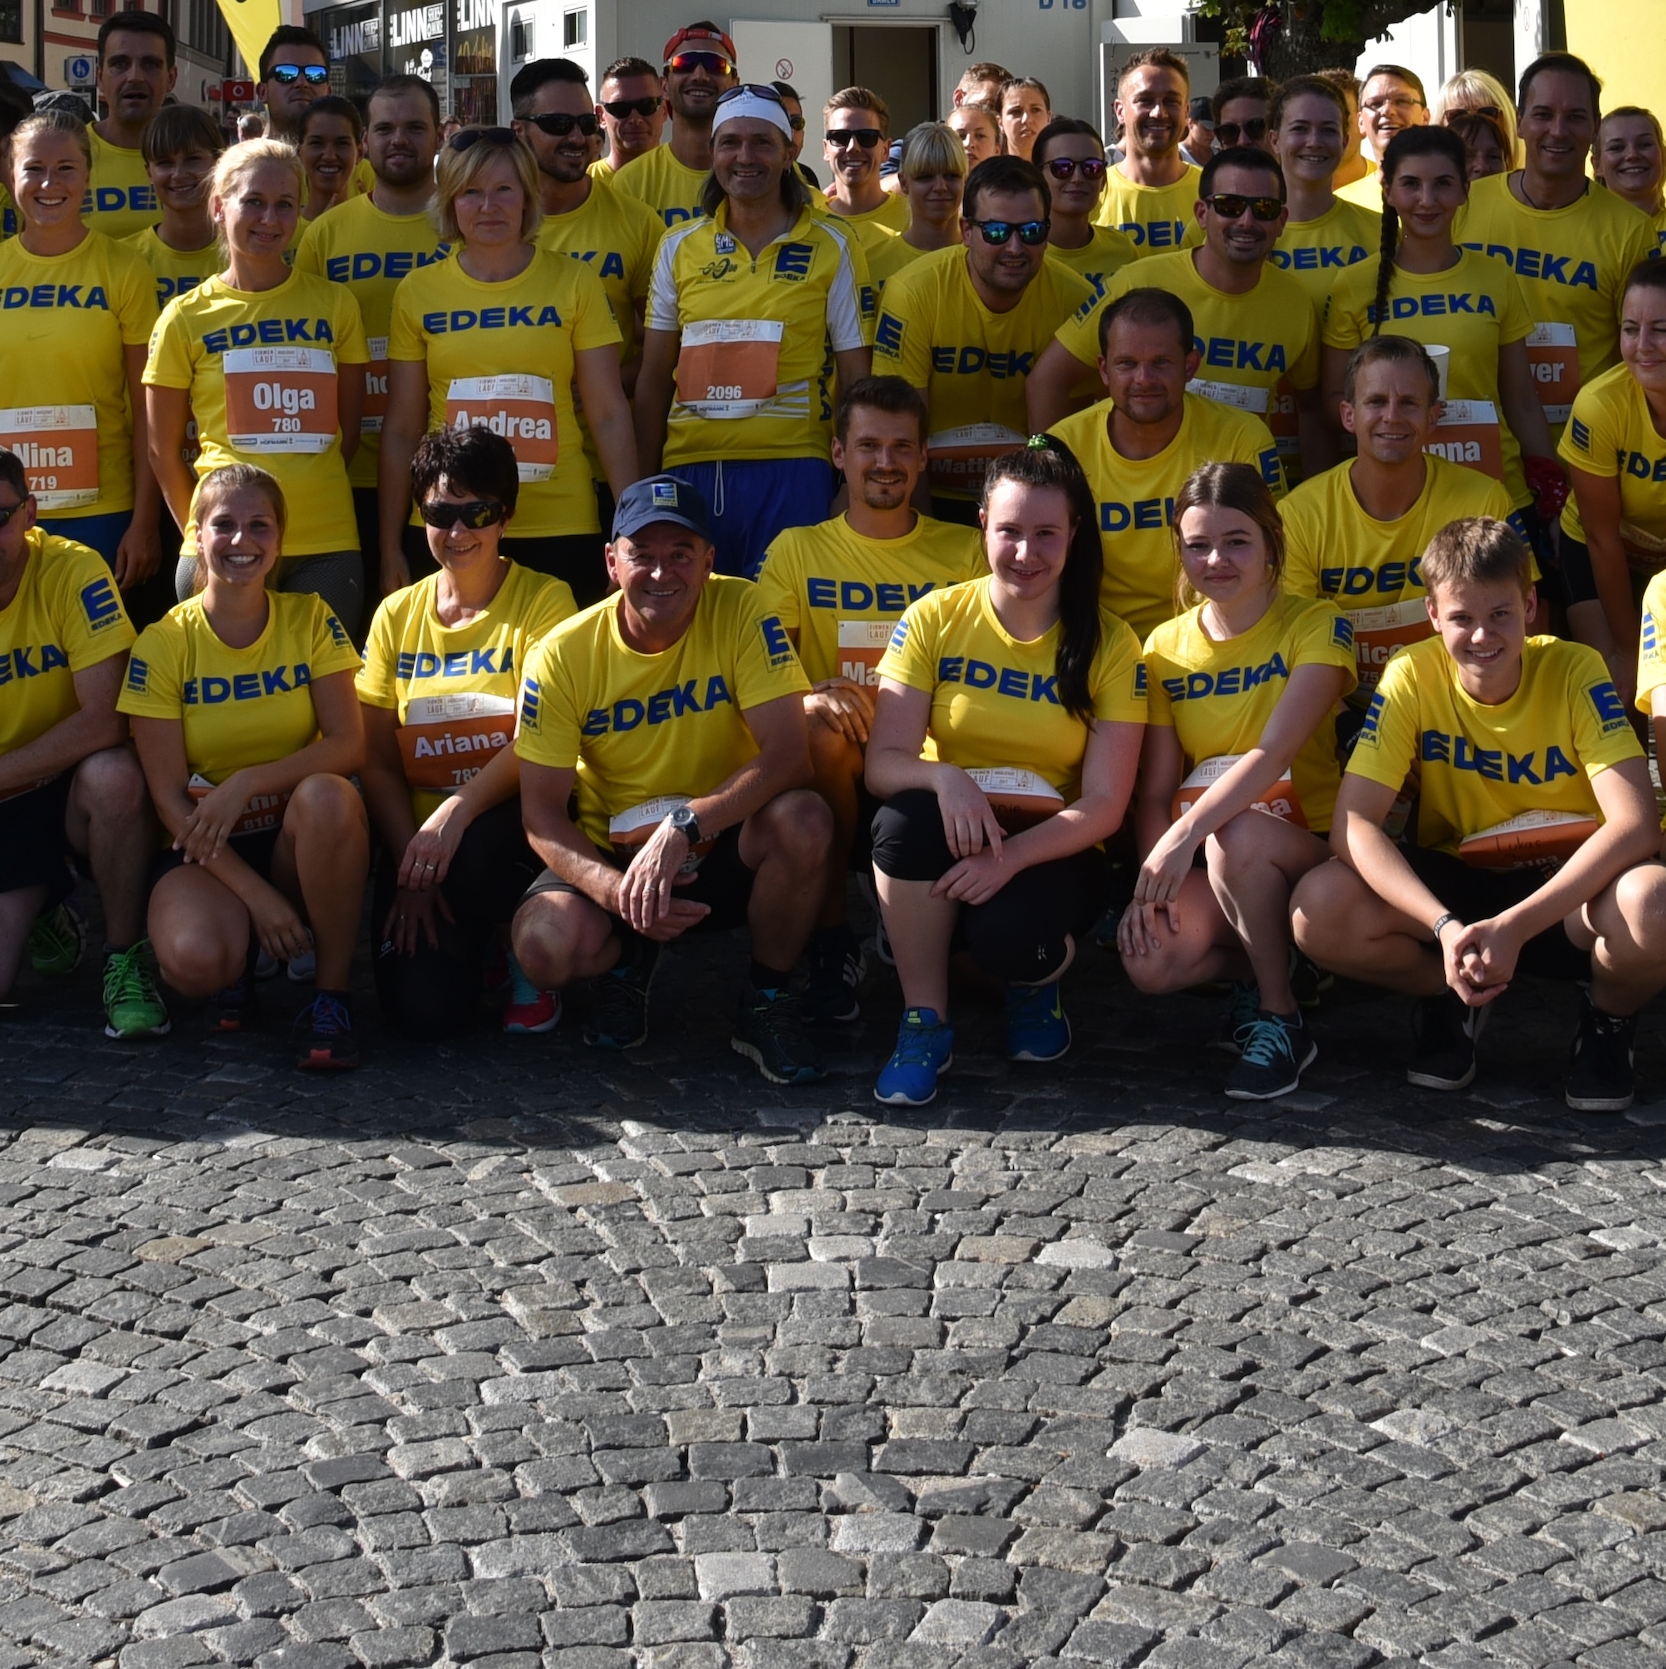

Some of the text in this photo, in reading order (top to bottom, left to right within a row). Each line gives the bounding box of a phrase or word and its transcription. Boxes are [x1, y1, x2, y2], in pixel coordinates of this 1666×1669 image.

[333, 23, 363, 59] LINN
[393, 8, 426, 47] LINN
[1269, 246, 1368, 270] DEKA
[423, 305, 562, 334] EDEKA
[202, 318, 334, 354] EDEKA
[254, 355, 274, 364] LAUF
[1192, 336, 1287, 373] DEKA
[253, 382, 315, 415] Olga
[707, 386, 742, 399] 2096
[272, 417, 301, 433] 780
[454, 410, 552, 440] Andrea
[12, 442, 74, 468] Nina
[28, 476, 58, 491] 719
[80, 578, 120, 623] E
[91, 612, 123, 631] EDEKA
[868, 629, 890, 640] LAUF
[397, 647, 515, 679] EDEKA
[1162, 652, 1288, 703] EDEKA
[183, 662, 311, 706] EDEKA
[938, 656, 1060, 704] EDEK
[581, 674, 733, 736] EDEKA
[414, 729, 508, 760] Ariana
[1422, 730, 1578, 785] EDEKA
[244, 814, 275, 830] 810
[641, 805, 661, 817] LAUF
